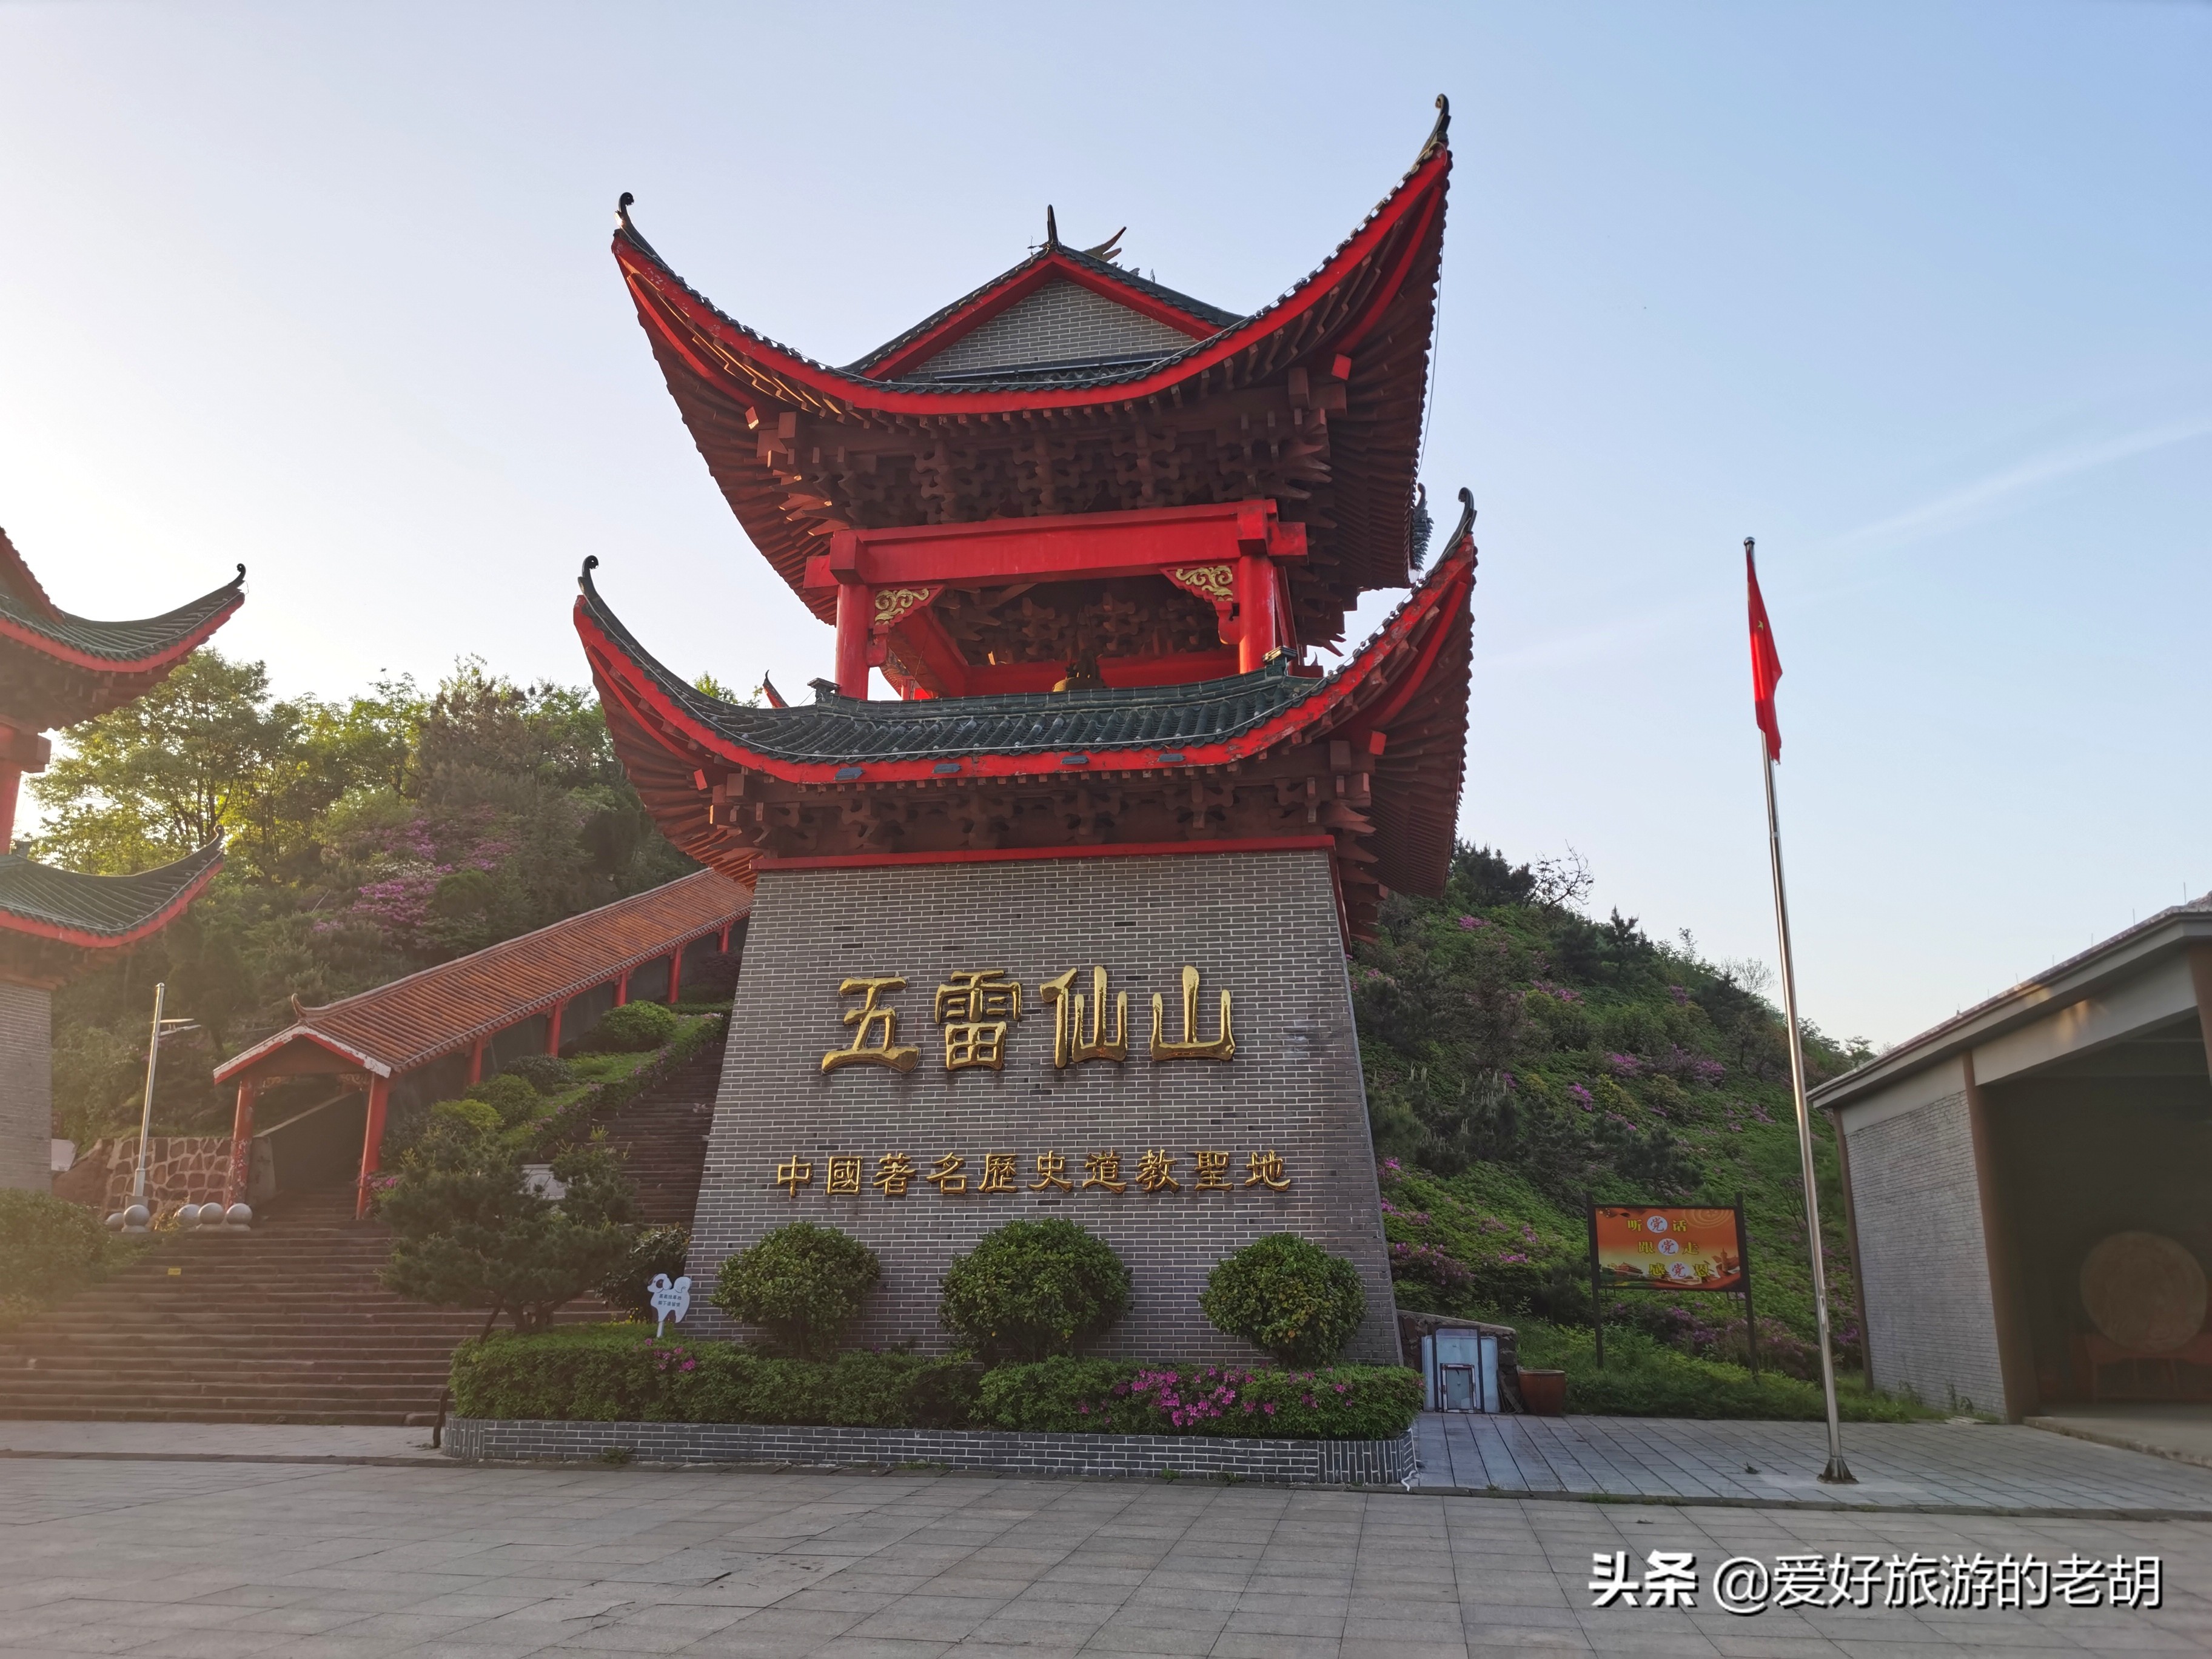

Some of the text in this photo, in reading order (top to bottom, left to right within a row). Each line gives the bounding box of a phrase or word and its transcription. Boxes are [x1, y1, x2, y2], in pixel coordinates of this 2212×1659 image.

[820, 965, 1236, 1073] 五雷仙山
[776, 1149, 1291, 1198] 中國著名歷史道教聖地
[1627, 1216, 1687, 1232] 听党话
[1638, 1240, 1699, 1255] 跟党走
[1649, 1262, 1710, 1277] 感党恩
